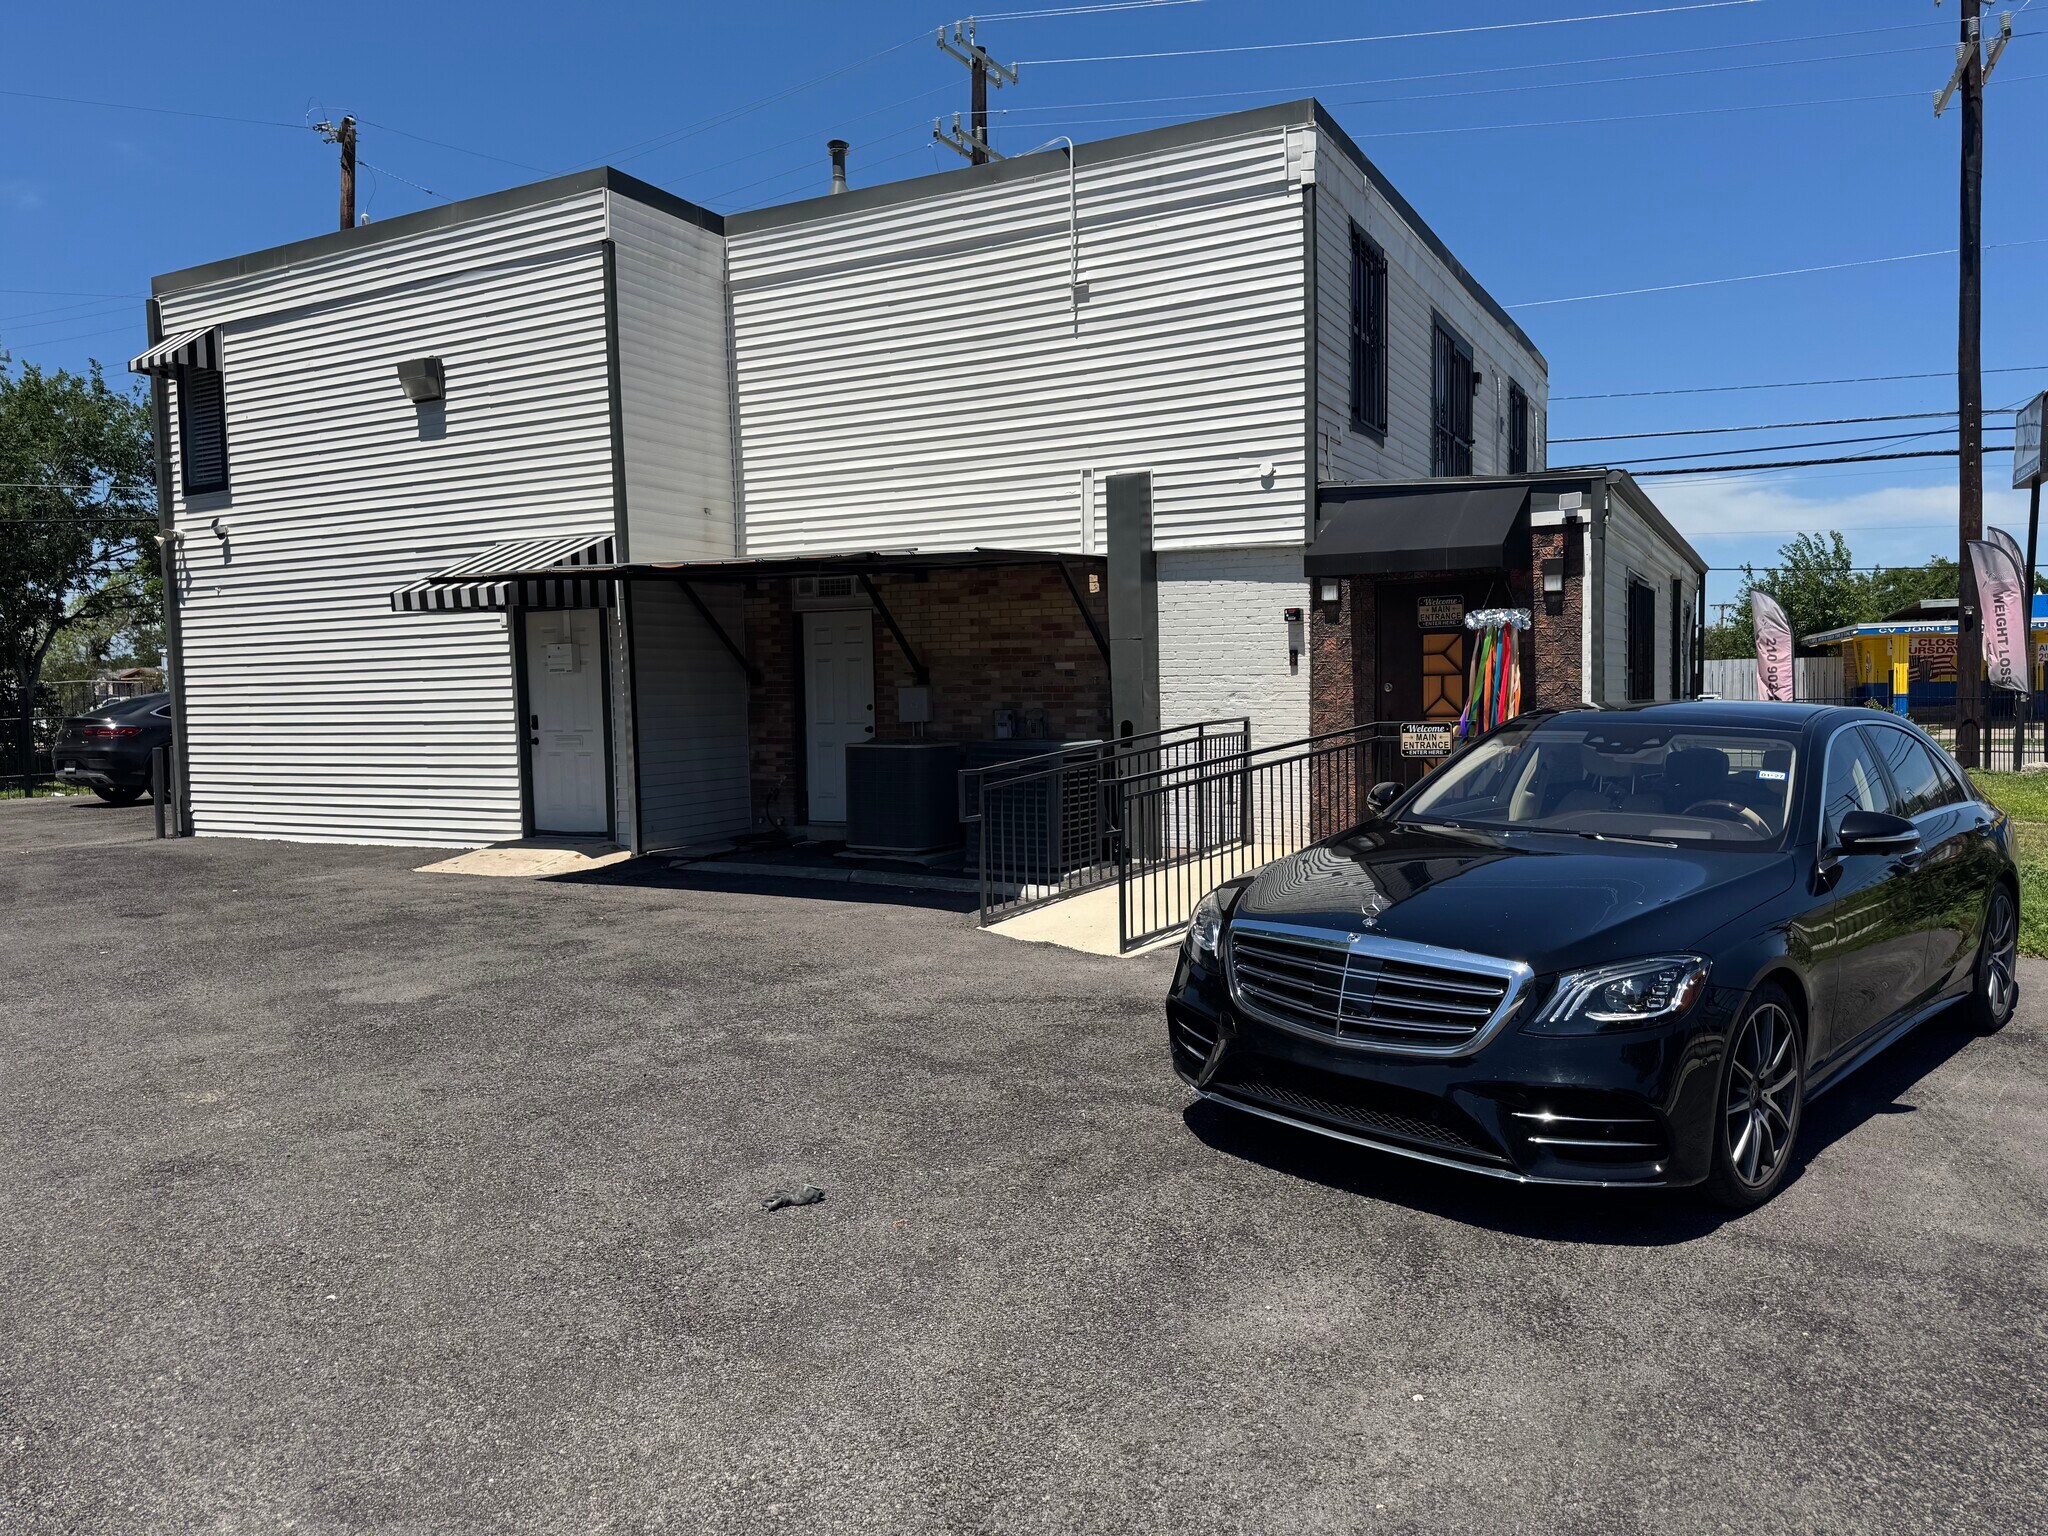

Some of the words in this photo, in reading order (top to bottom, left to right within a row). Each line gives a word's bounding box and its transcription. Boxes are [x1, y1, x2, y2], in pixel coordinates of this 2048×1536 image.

[1424, 598, 1458, 606] Welcome
[1431, 605, 1451, 613] MAIN
[1420, 611, 1462, 621] ENTRANCE
[1992, 591, 2009, 645] WEIGHT
[1918, 638, 1958, 646] CLOS
[1766, 638, 1778, 662] 210
[1998, 649, 2012, 685] LOSS
[1406, 724, 1445, 733] Welcome
[1416, 733, 1437, 741] MAIN
[1404, 741, 1449, 749] ENTRANCE
